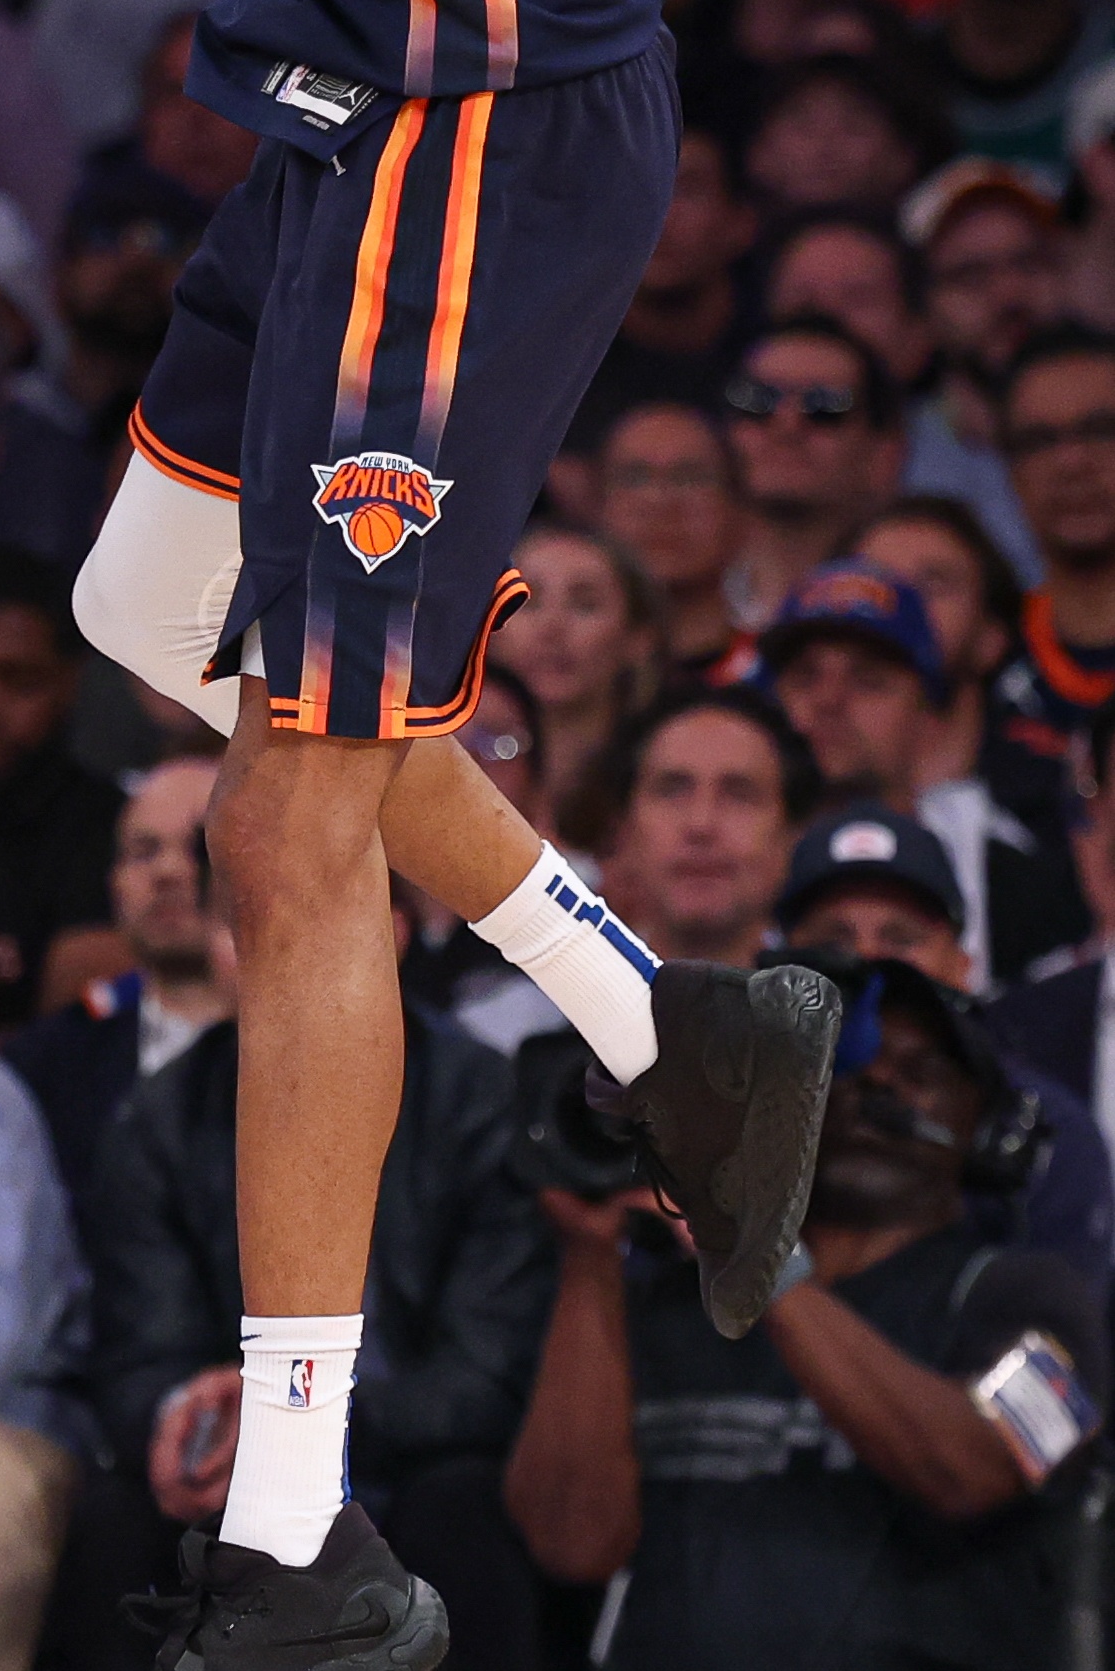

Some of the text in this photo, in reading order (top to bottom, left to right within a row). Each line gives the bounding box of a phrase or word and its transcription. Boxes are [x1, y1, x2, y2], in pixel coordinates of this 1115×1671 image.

[360, 456, 410, 473] NEW YORK
[318, 461, 436, 519] KNICKS
